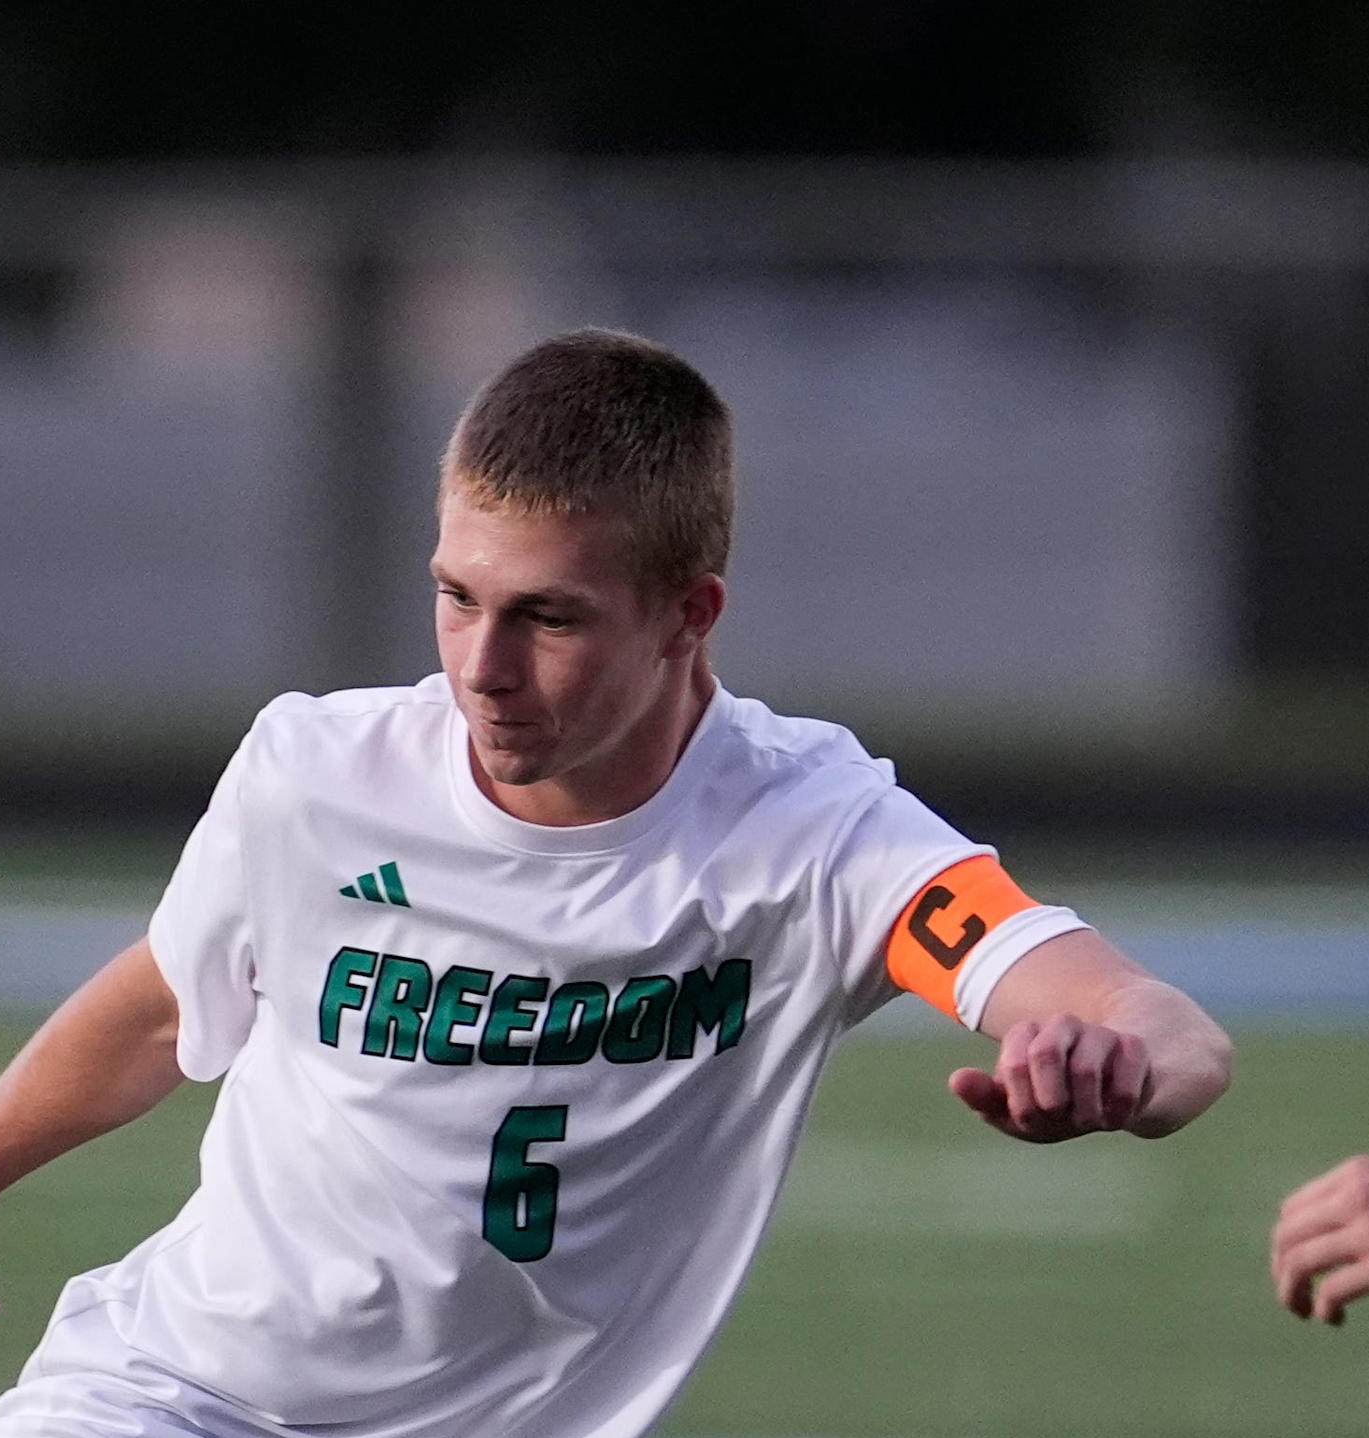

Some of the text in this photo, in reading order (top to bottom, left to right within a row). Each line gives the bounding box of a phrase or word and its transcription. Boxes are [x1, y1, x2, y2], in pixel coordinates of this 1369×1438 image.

[907, 884, 986, 971] C
[318, 945, 753, 1067] FREEDOM
[482, 1104, 570, 1264] 6
